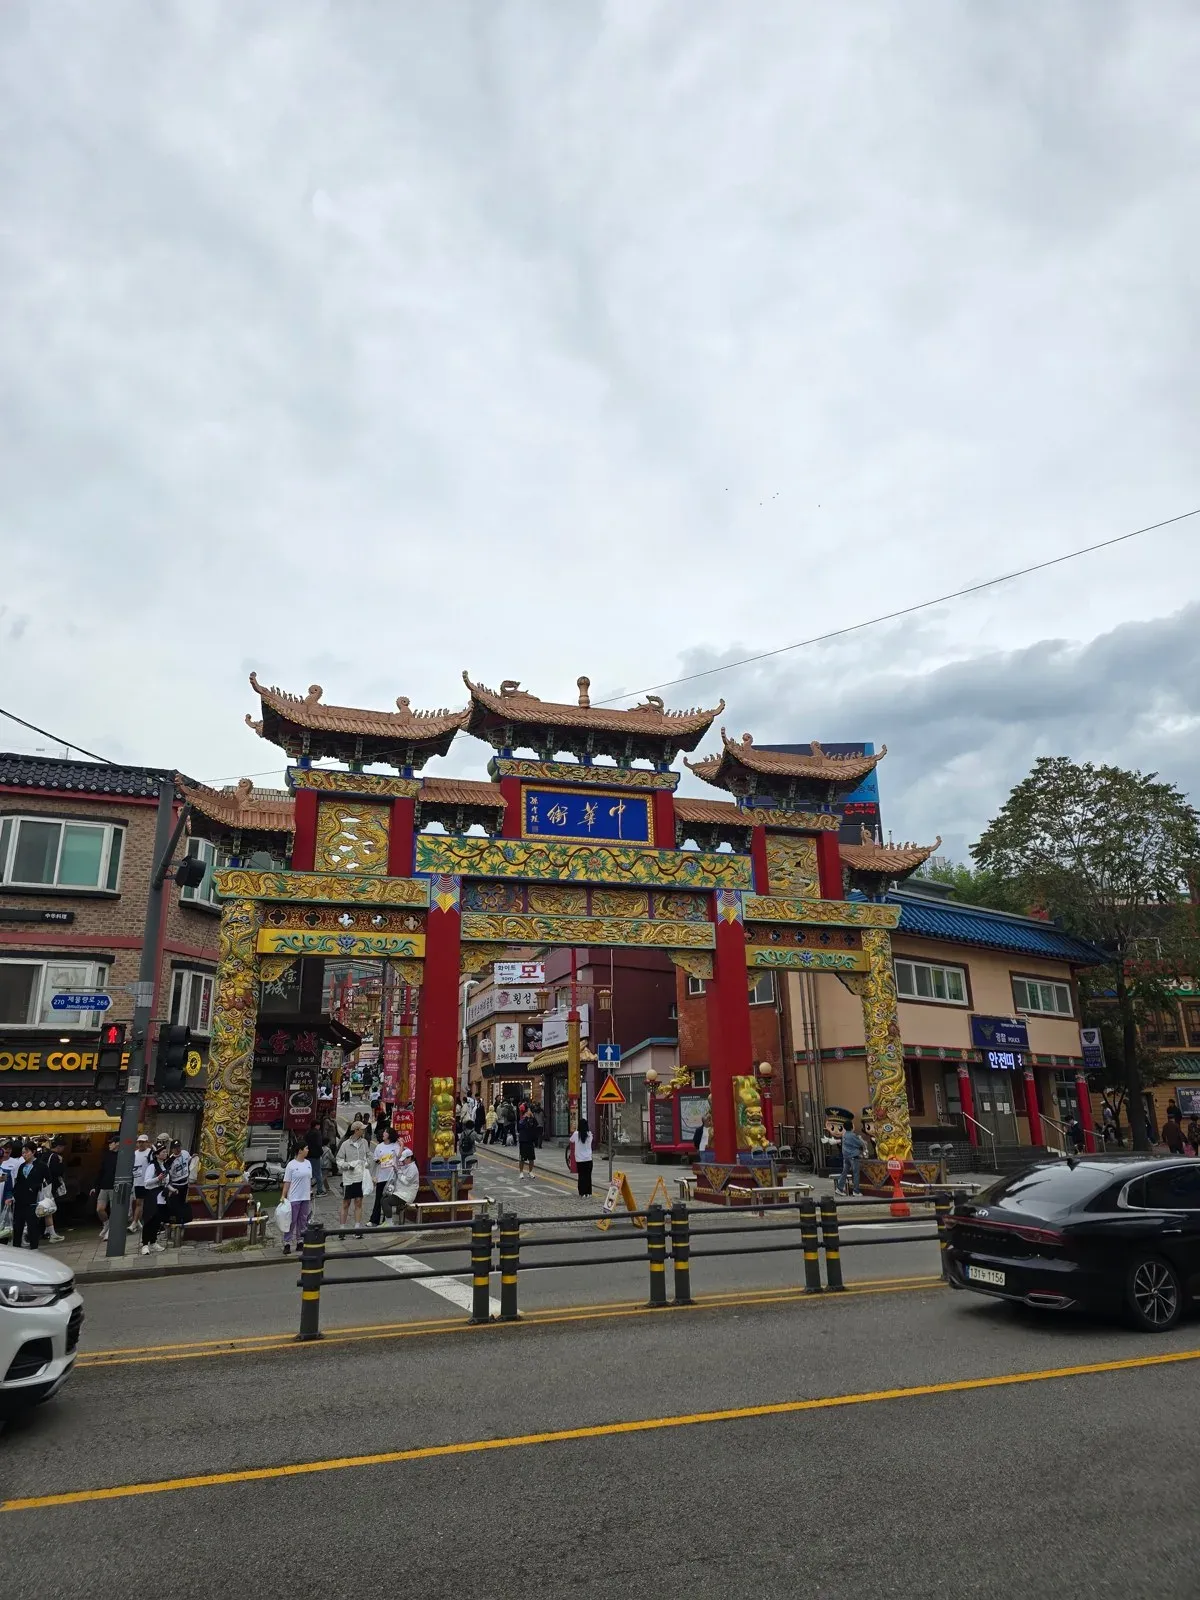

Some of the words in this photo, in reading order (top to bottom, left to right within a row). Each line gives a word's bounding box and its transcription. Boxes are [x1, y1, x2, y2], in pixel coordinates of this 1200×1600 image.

[68, 996, 95, 1004] 제물량로
[995, 1032, 1007, 1043] 경찰
[988, 1051, 1016, 1070] 안전띠
